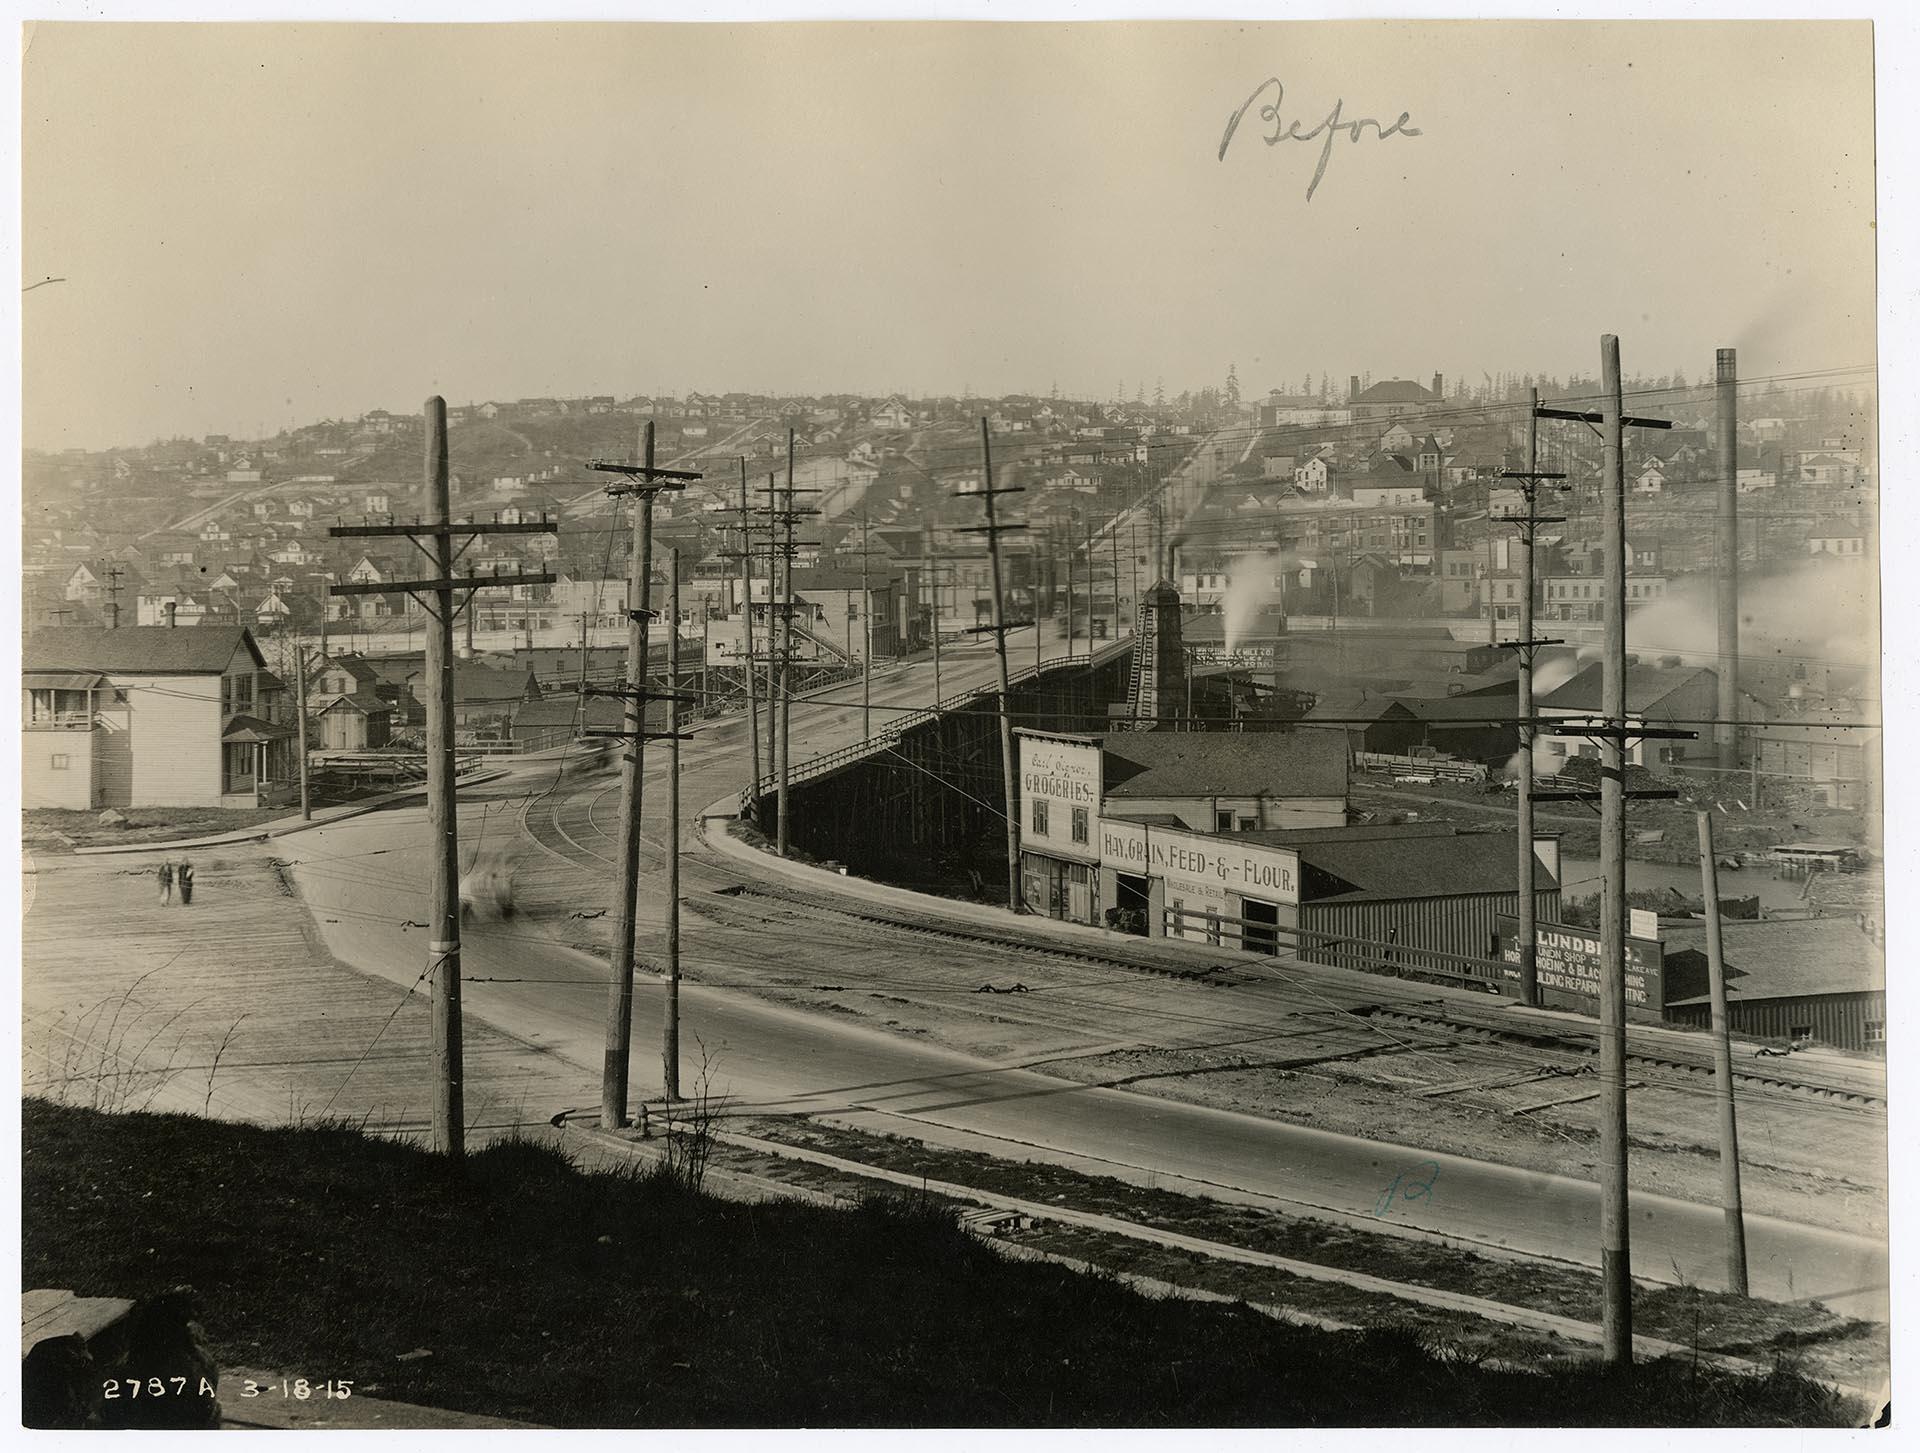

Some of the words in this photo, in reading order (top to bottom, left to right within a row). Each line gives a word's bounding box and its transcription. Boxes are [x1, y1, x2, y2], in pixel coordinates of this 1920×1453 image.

[1218, 76, 1423, 203] Before
[1535, 956, 1566, 974] HOEING
[1568, 962, 1576, 975] &
[1564, 951, 1586, 964] SHOP
